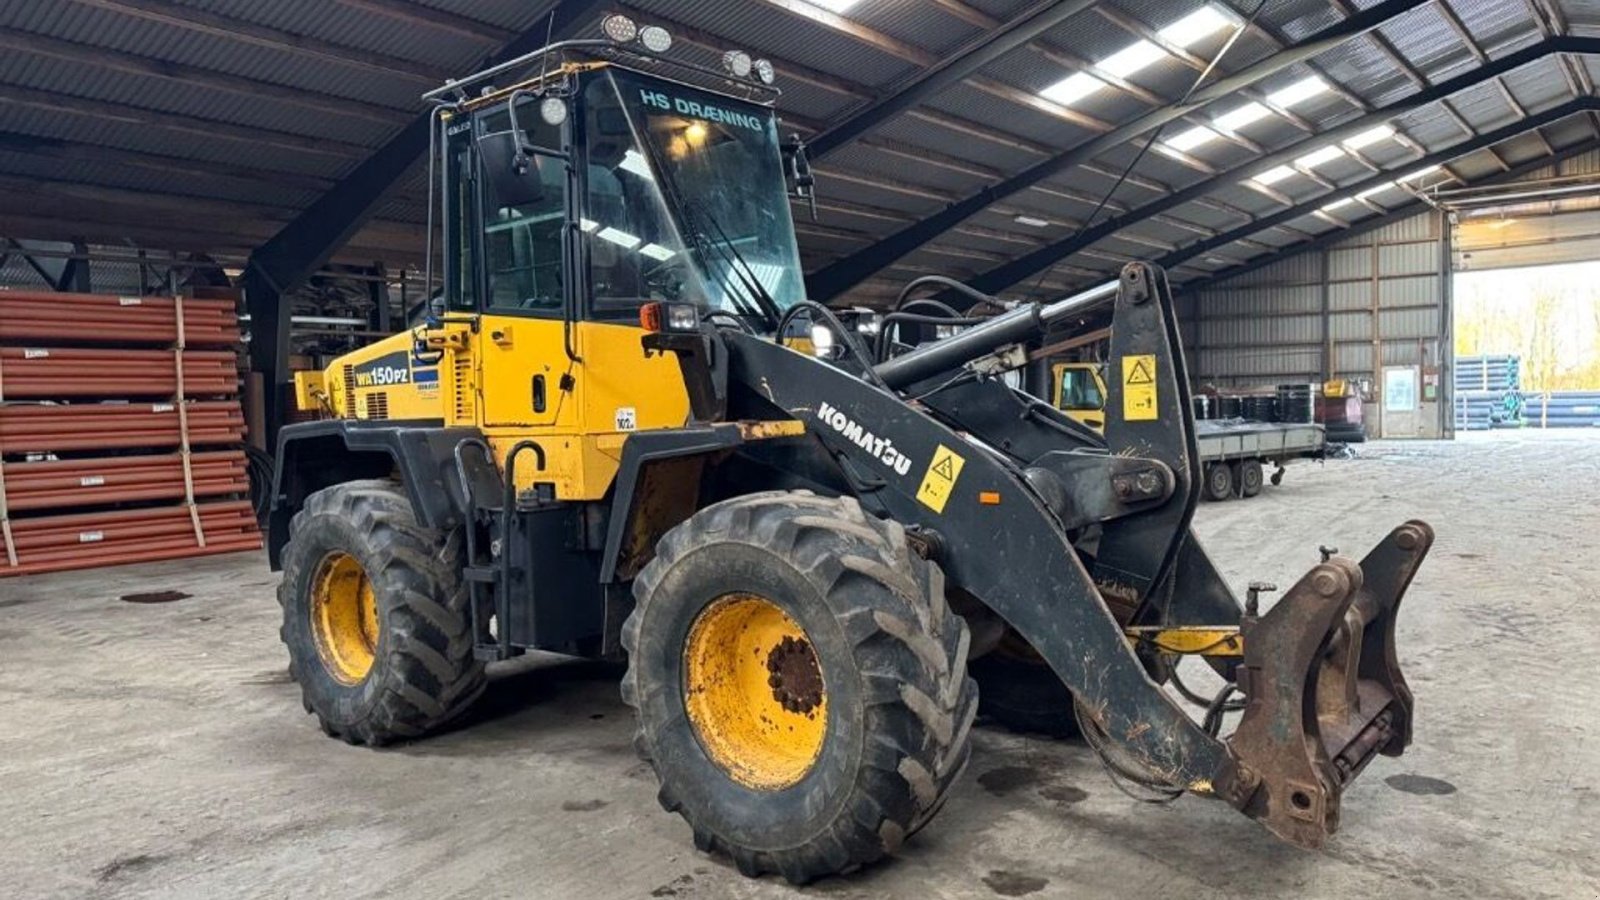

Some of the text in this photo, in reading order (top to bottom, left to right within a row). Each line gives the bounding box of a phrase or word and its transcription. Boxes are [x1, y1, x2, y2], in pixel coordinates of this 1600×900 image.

[640, 89, 762, 131] HS DRÆNING
[356, 366, 408, 386] WA150PZ
[817, 401, 912, 476] KOMATSU
